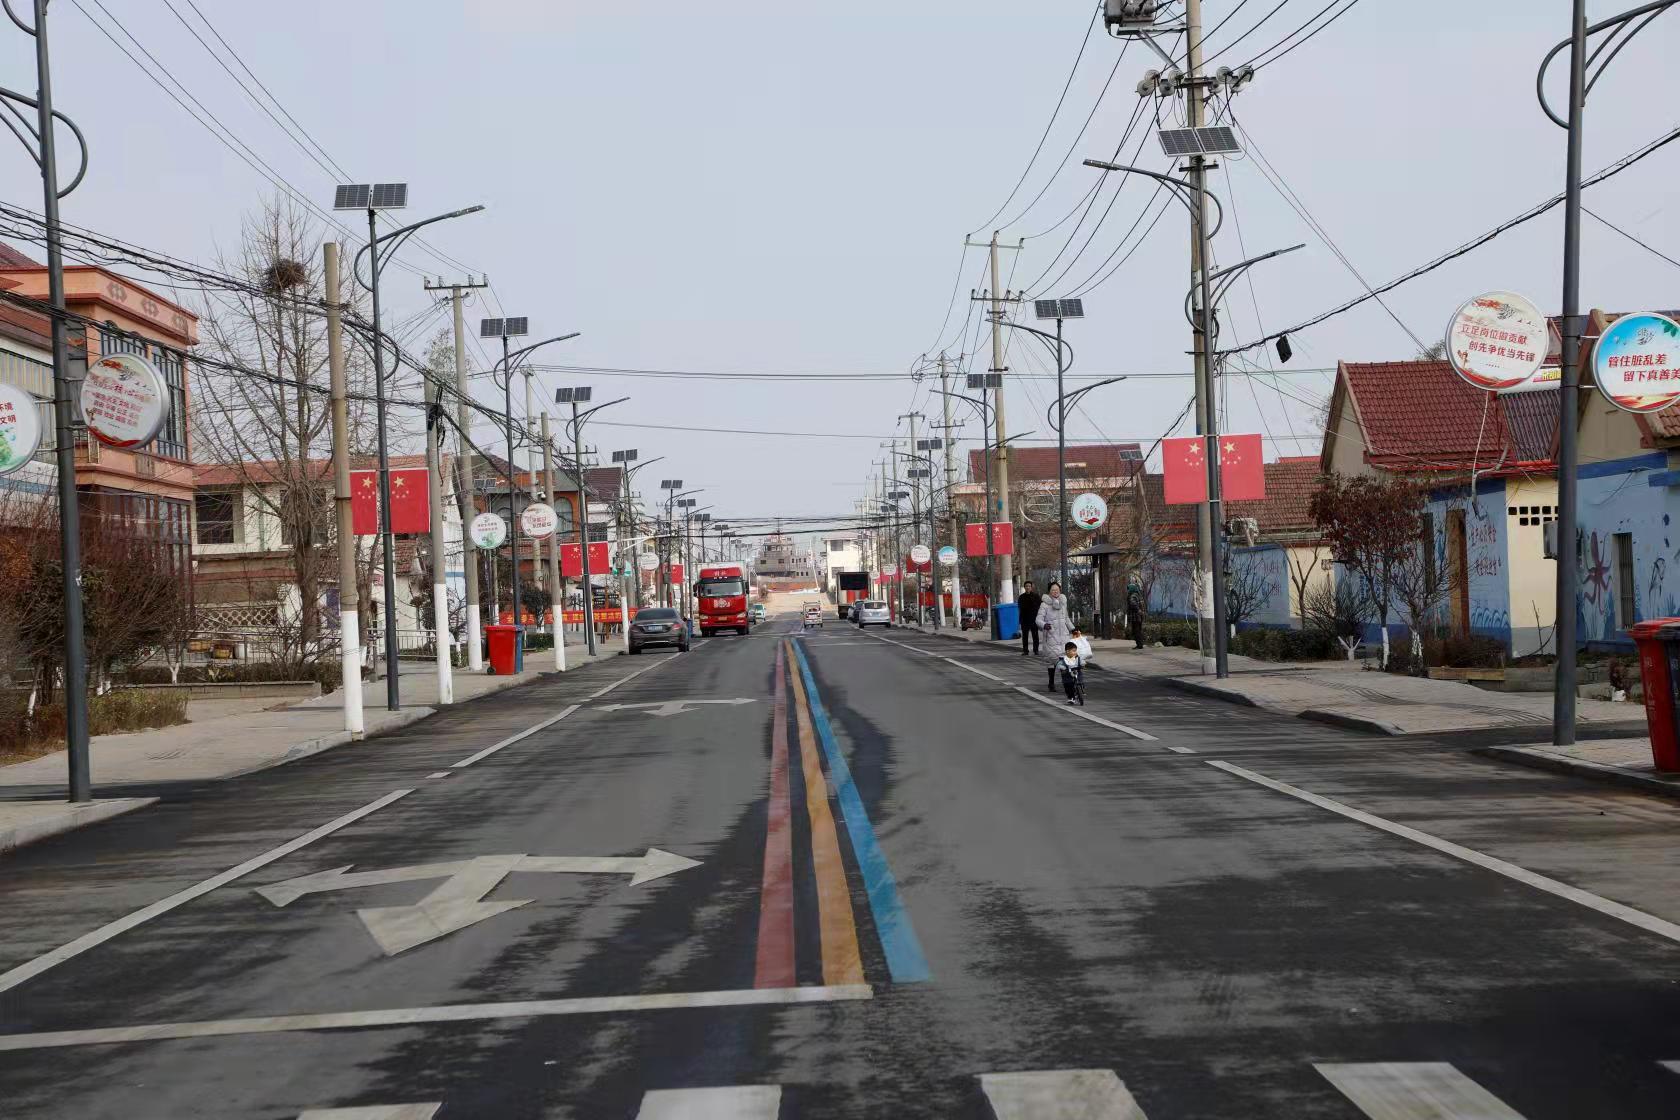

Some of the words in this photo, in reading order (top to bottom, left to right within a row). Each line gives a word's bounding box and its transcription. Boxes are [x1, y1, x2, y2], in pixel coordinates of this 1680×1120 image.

[1468, 340, 1536, 362] 创先争优当先锋
[1608, 353, 1667, 368] 管住脏乱差
[1624, 367, 1680, 382] 留下真善美
